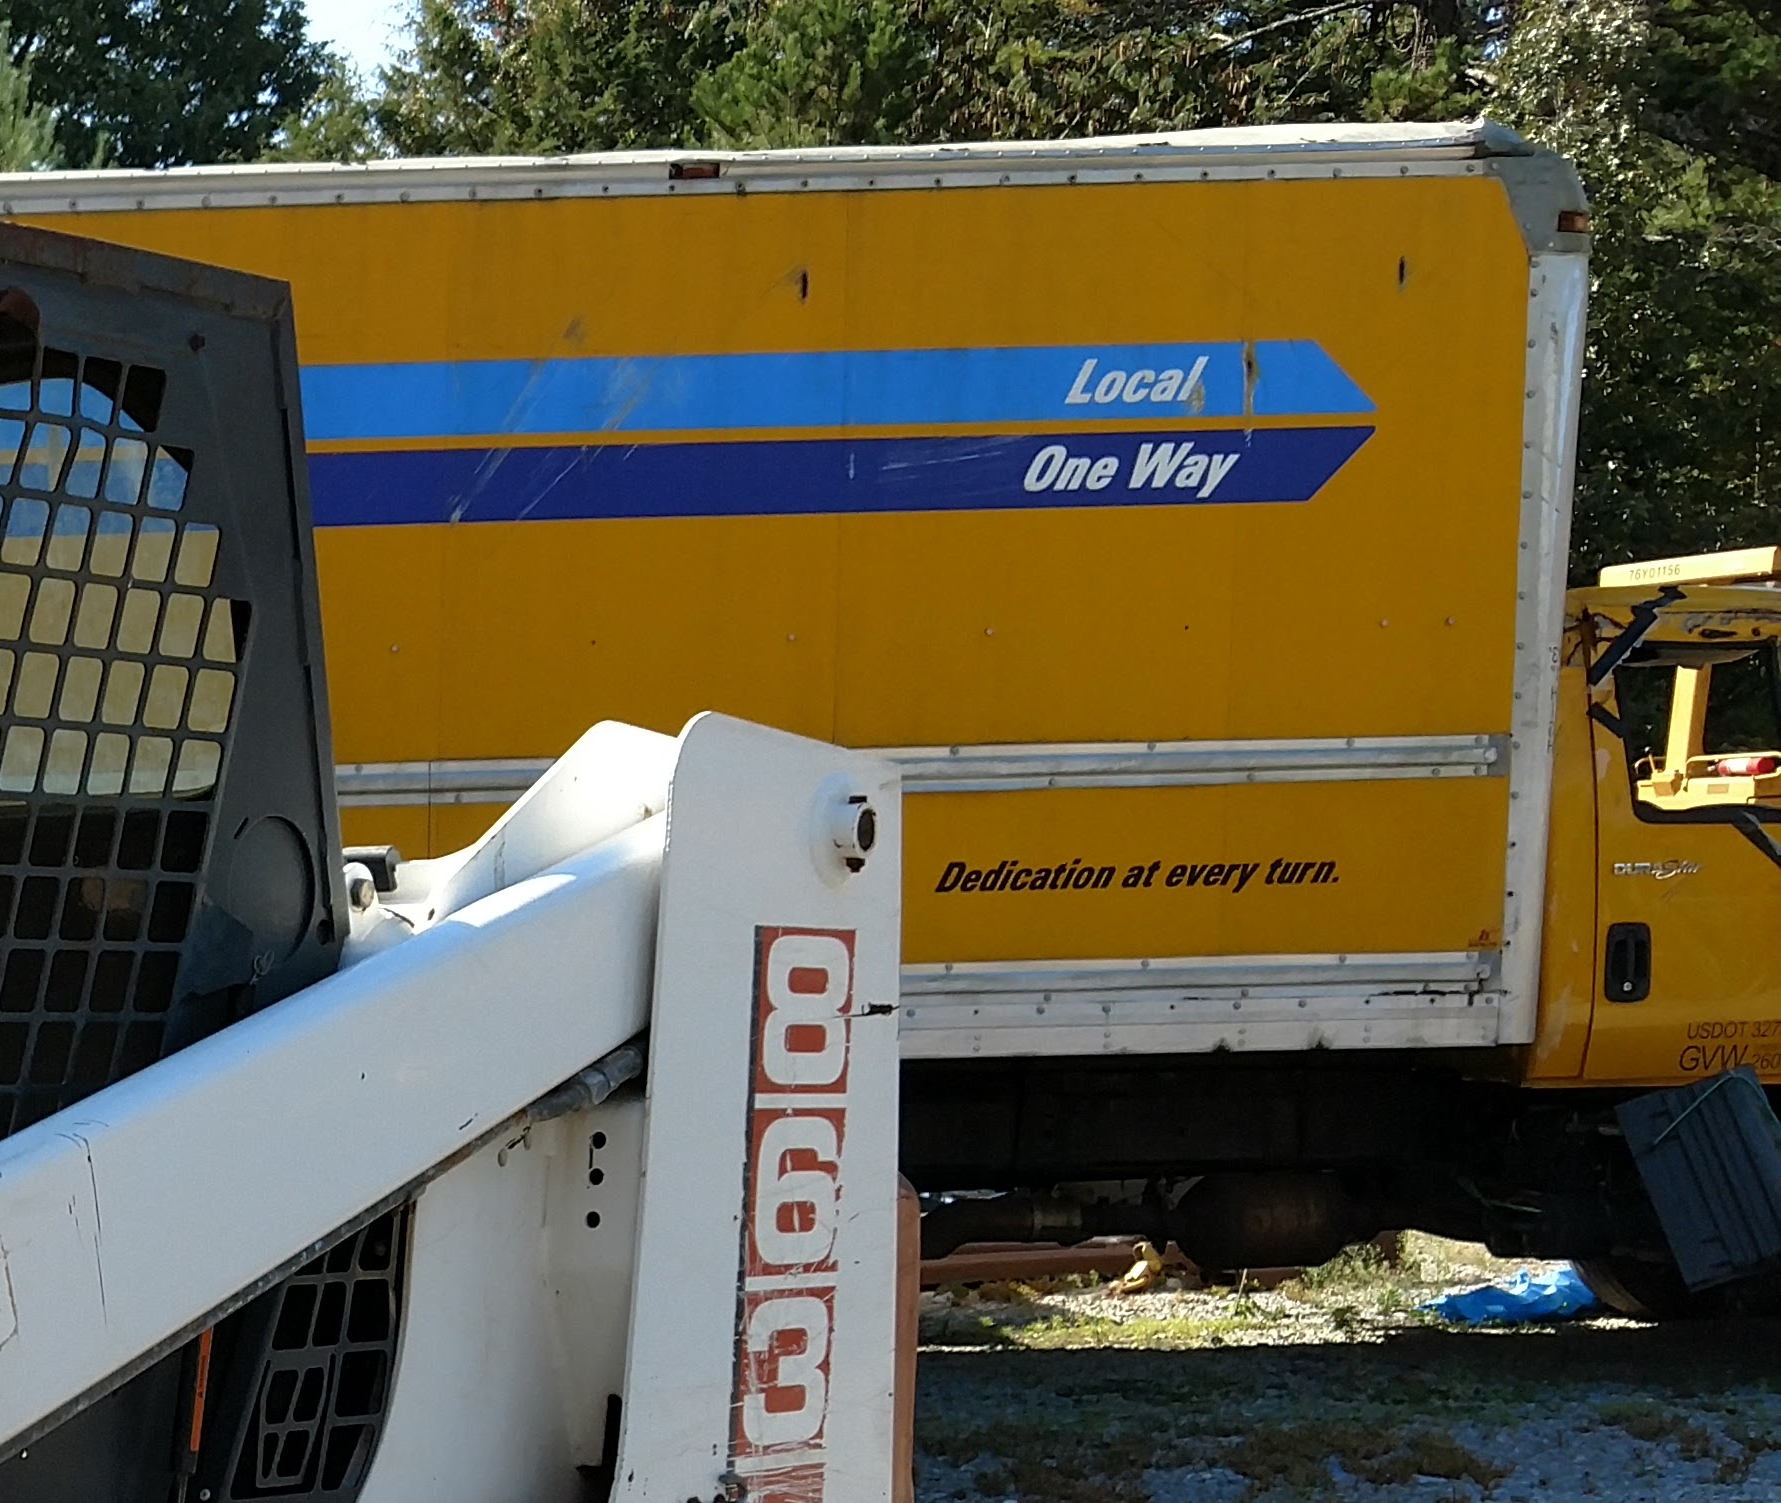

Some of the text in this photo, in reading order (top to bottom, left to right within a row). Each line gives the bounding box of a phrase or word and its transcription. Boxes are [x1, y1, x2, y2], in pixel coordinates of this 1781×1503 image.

[1064, 355, 1210, 405] Local
[1023, 441, 1241, 499] One Way
[934, 857, 1341, 894] Dedication at every turn.
[1687, 1021, 1781, 1039] USDOT 327
[1678, 1044, 1749, 1072] GVW
[743, 934, 850, 1447] 863
